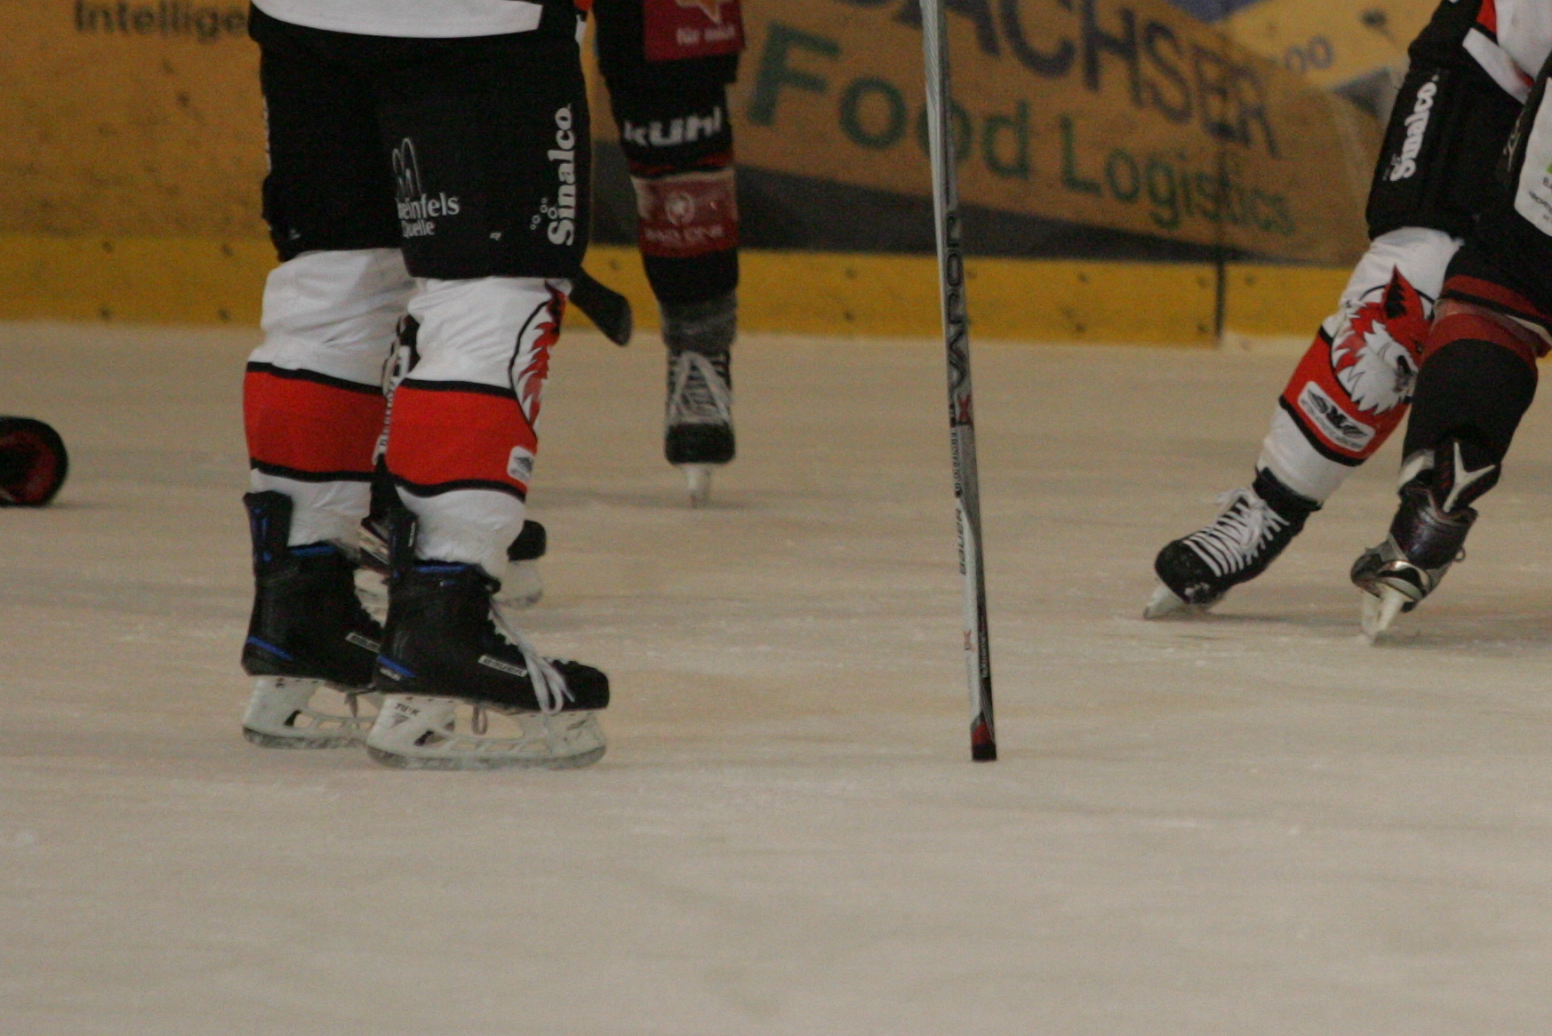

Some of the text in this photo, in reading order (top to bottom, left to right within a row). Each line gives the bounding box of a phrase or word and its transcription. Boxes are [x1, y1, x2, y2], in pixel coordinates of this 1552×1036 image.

[547, 105, 576, 247] Sinalco
[746, 21, 1297, 235] Food Logistics
